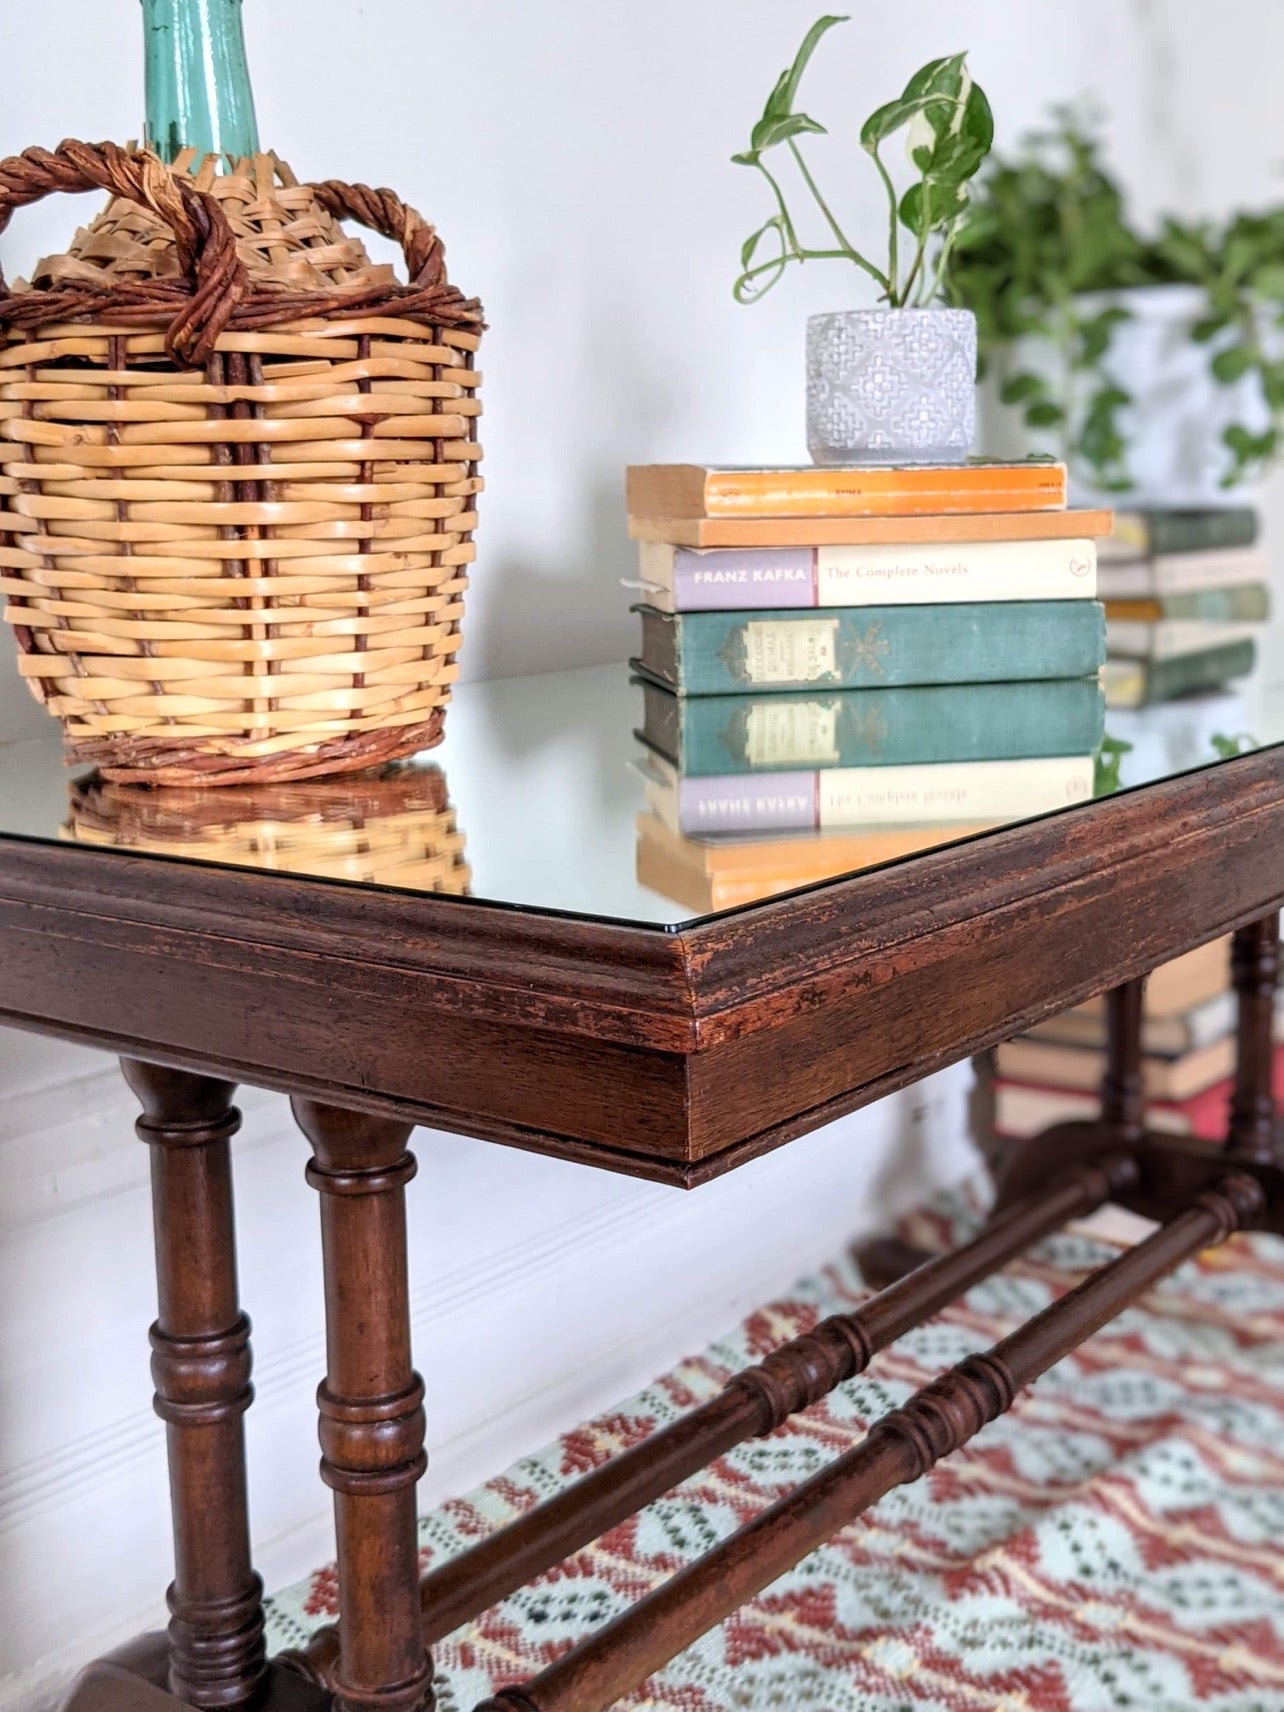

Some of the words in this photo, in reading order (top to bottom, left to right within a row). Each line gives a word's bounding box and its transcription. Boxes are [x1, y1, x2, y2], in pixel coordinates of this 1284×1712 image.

[694, 570, 748, 585] FRANZ
[752, 567, 807, 583] KAFKA
[828, 567, 850, 579] The
[856, 564, 918, 580] Complete
[923, 562, 968, 576] Novels
